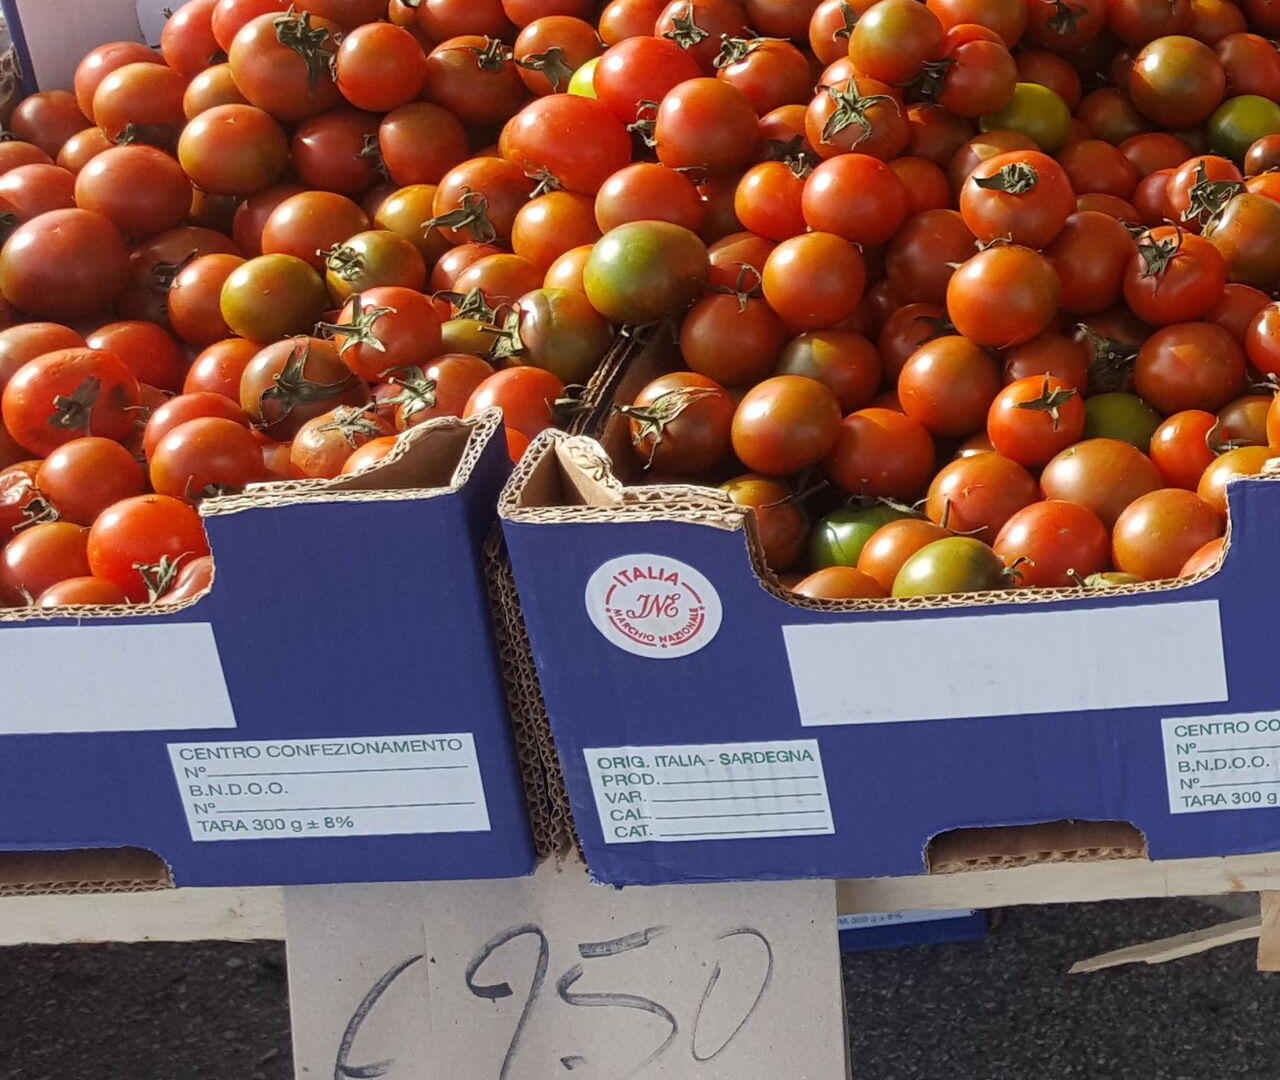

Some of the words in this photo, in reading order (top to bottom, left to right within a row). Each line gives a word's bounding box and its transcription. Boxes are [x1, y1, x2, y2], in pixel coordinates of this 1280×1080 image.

[613, 566, 679, 587] ITALIA
[613, 609, 655, 643] MARCHIO
[659, 608, 699, 643] NAZIONALE
[1174, 721, 1250, 738] CENTRO
[179, 746, 261, 761] CENTRO
[266, 738, 463, 758] CONFEZIONAMENTO
[597, 755, 650, 770] ORIG.
[655, 754, 706, 768] ITALIA
[719, 749, 815, 766] SARDEGNA
[1178, 756, 1270, 773] B.N.D.O.O.
[602, 772, 660, 787] PROD.
[189, 782, 289, 797] B.N.D.O.O.
[605, 791, 647, 805] VAR.
[1181, 793, 1227, 807] TARA
[1231, 791, 1262, 804] 300
[1267, 792, 1278, 805] g
[610, 808, 652, 821] CAL.
[197, 819, 248, 833] TARA
[252, 818, 286, 831] 300
[291, 819, 303, 833] g
[307, 819, 320, 830] ±
[324, 816, 354, 829] 8%
[614, 824, 653, 838] CAT.
